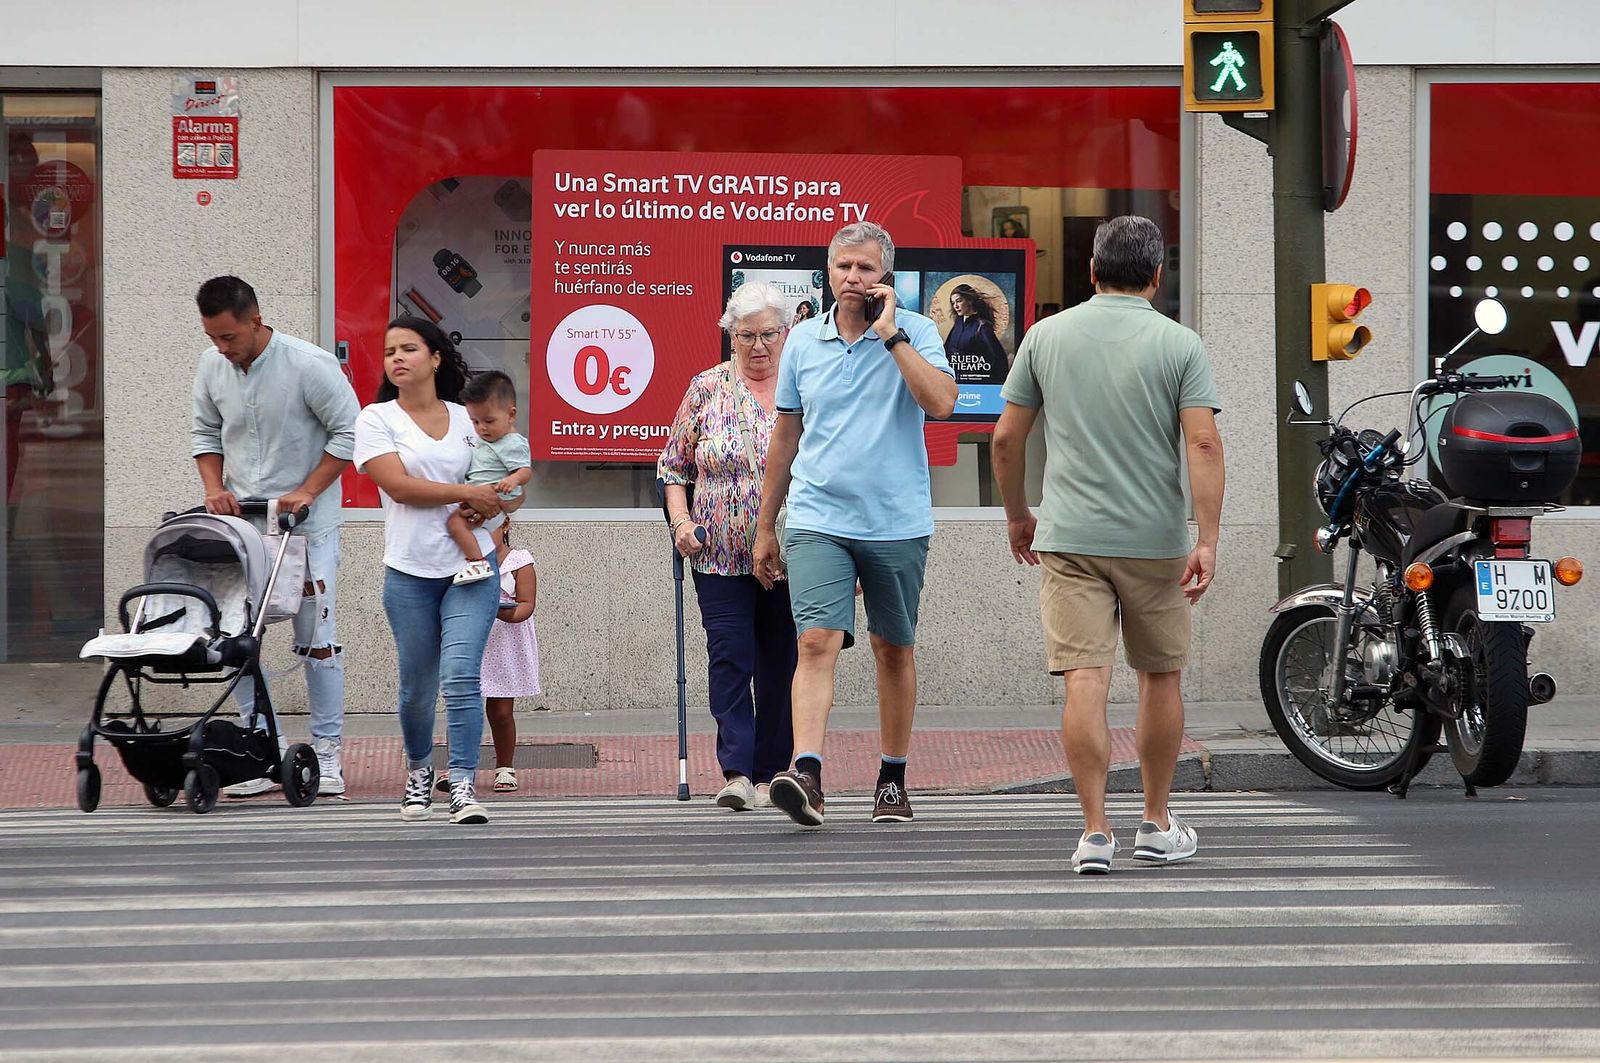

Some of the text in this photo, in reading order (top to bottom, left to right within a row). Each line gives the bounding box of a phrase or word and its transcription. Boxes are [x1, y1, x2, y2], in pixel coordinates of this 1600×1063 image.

[178, 119, 234, 134] Alarma
[555, 173, 841, 199] Una Smart TV GRATIS para
[553, 199, 869, 222] ver lo último de Vodafone TV
[495, 244, 519, 254] FOR
[554, 240, 651, 257] Y nunca más
[744, 253, 796, 262] Vodafone TV
[554, 259, 633, 276] te sentirás
[554, 278, 693, 296] huérfano de series
[779, 284, 810, 294] THAT
[566, 328, 599, 339] Smart
[600, 329, 615, 340] TV
[950, 362, 991, 371] TIEMPO
[951, 355, 986, 363] RUEDA
[573, 345, 632, 396] 0€
[957, 391, 981, 401] prime
[551, 420, 671, 440] Entra y pregun
[1494, 565, 1546, 585] H M
[1482, 582, 1488, 590] E
[1496, 589, 1548, 610] 9700
